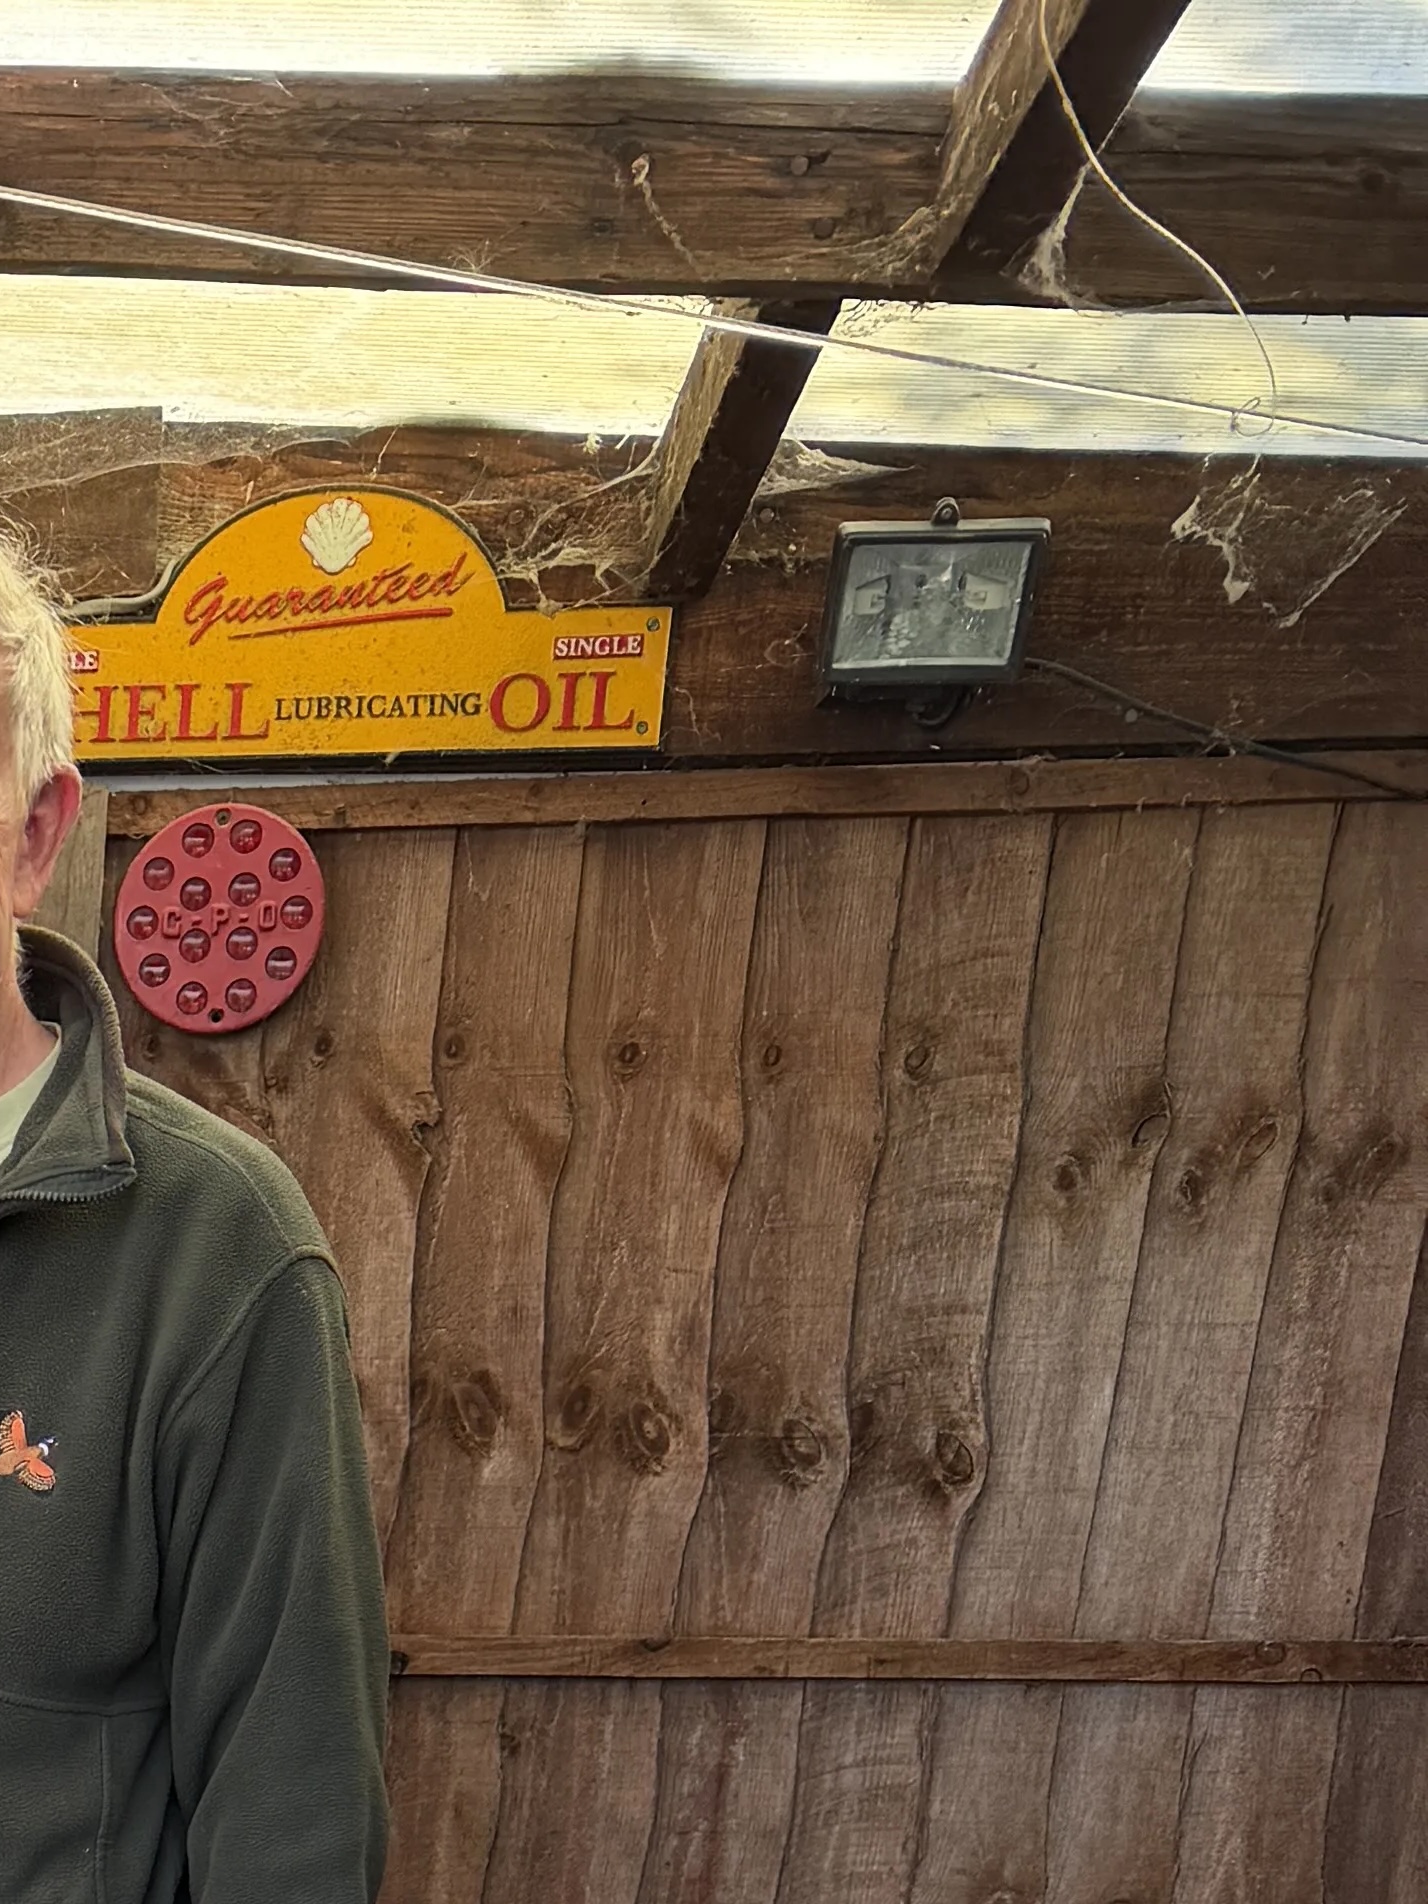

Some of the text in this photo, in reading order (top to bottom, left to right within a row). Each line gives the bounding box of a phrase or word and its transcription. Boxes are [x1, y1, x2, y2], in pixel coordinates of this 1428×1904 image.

[184, 553, 475, 646] Guaranteed
[555, 636, 641, 659] SINGLE
[72, 671, 635, 742] HELL LUBRICATING OIL
